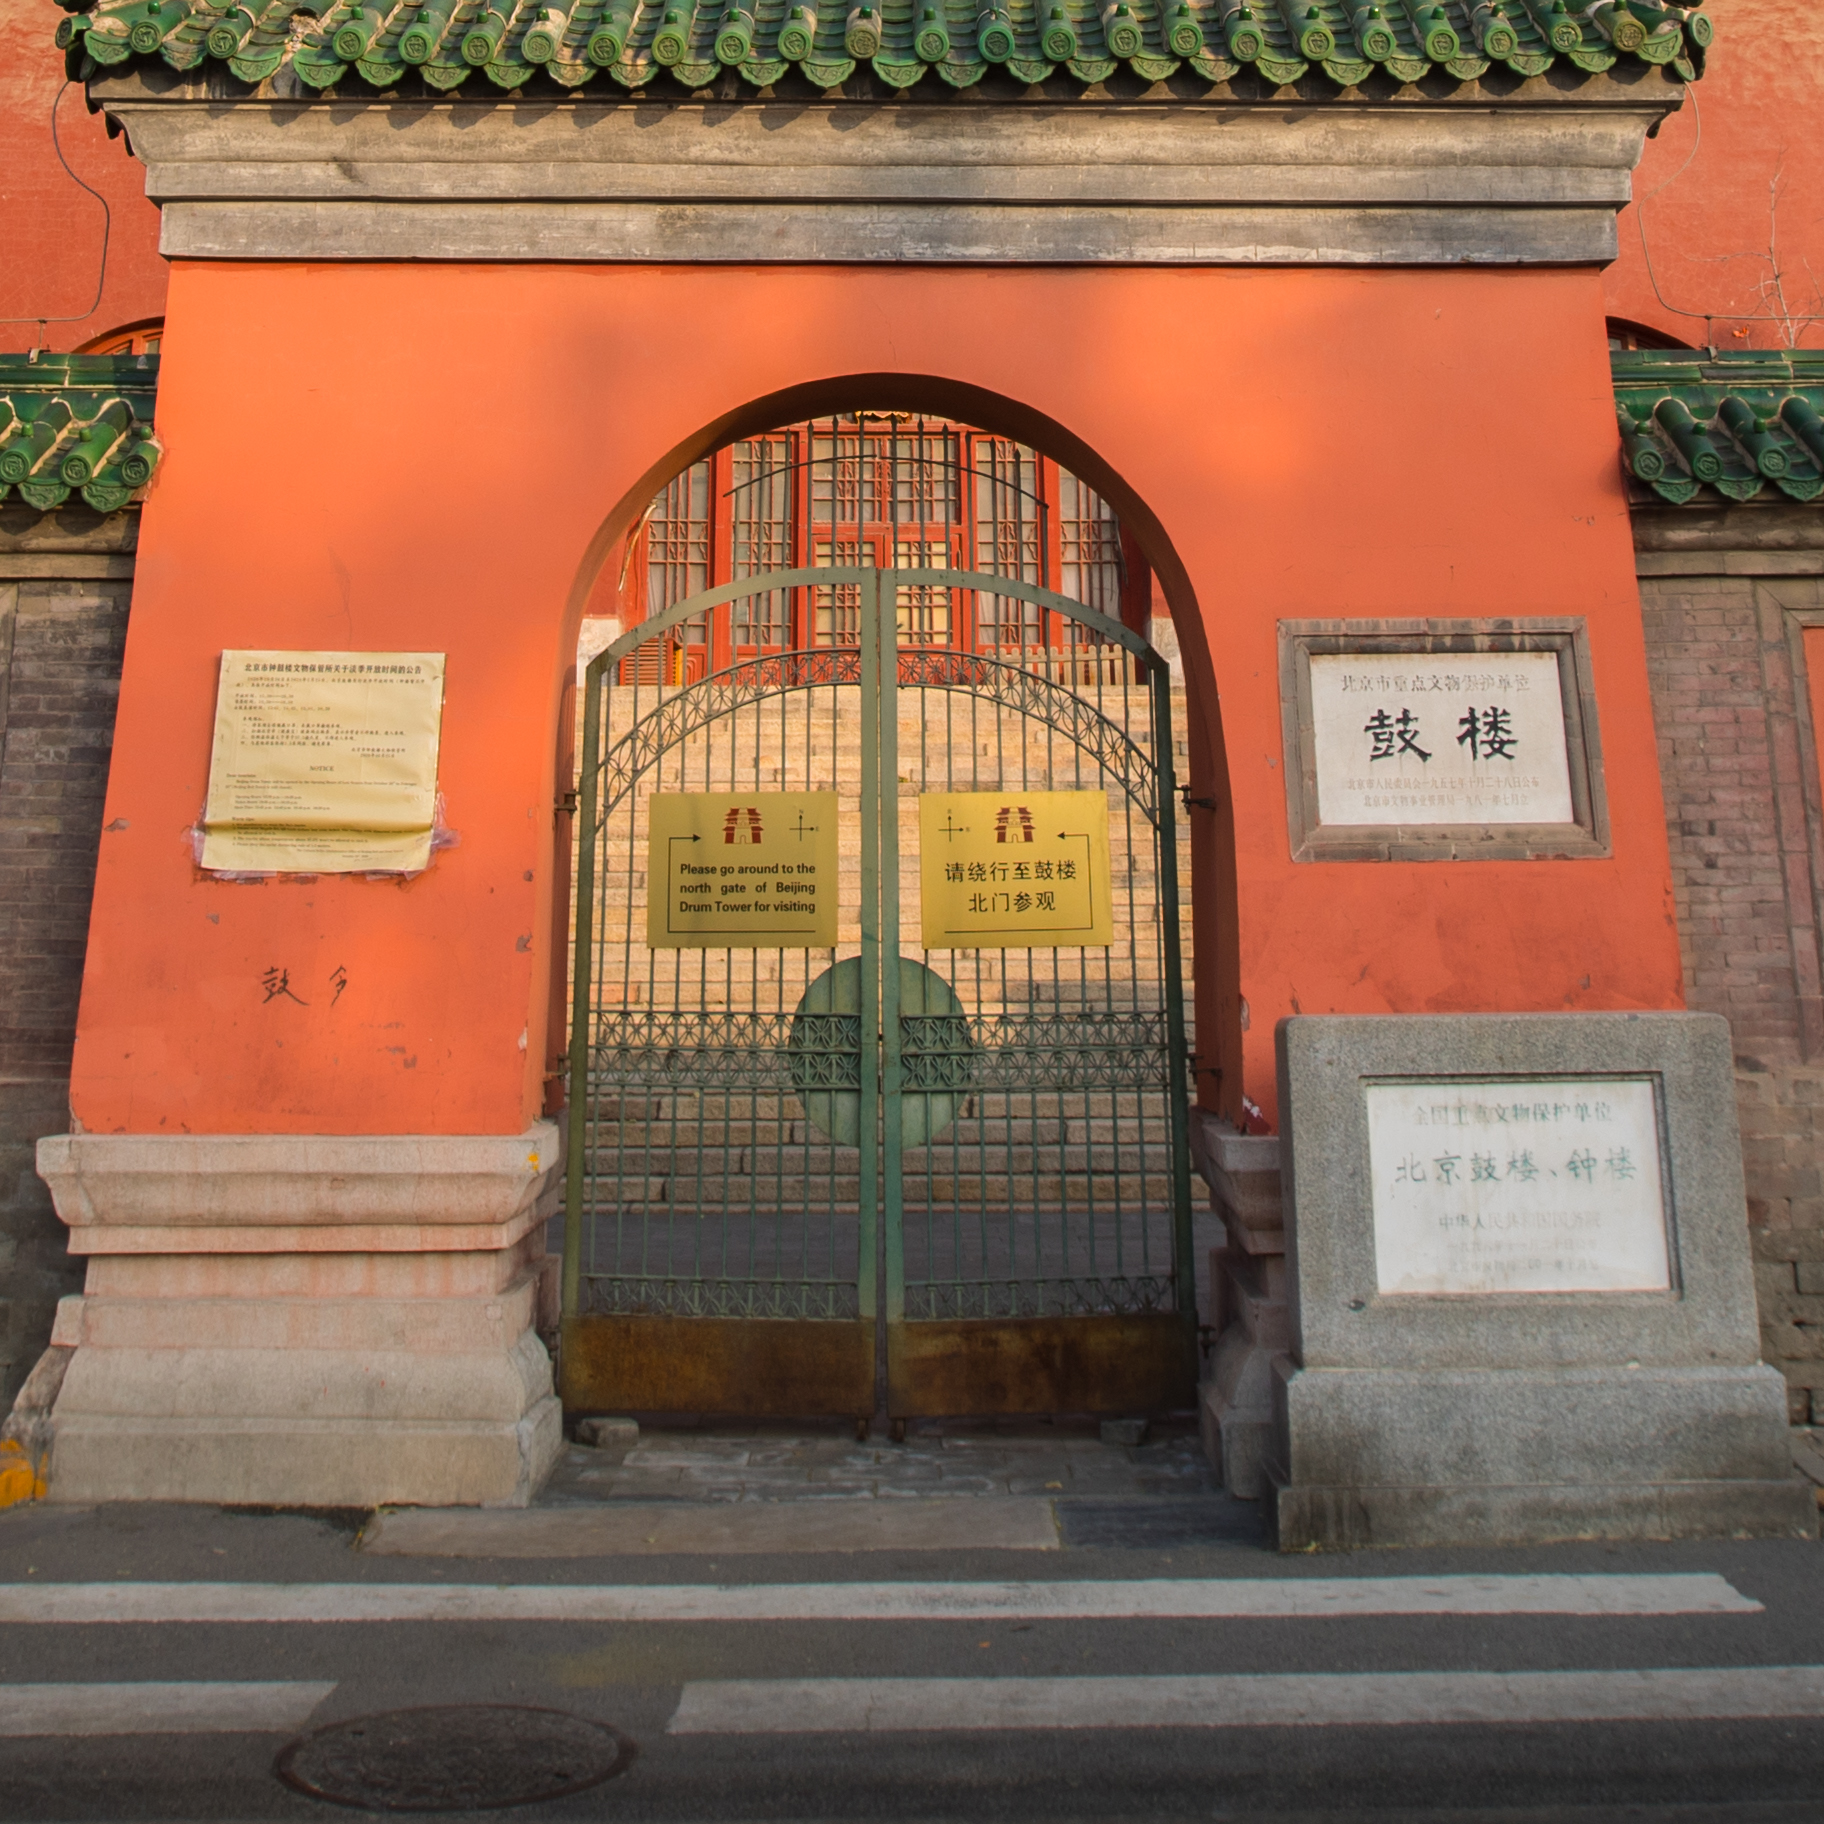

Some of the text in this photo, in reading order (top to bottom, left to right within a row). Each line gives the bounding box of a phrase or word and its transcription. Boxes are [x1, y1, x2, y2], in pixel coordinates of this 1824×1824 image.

[244, 663, 422, 675] 北京市钟鼓楼文物保管所关于淡季开放时间的公告
[1340, 674, 1530, 693] 北京市重点文物保护单位
[1363, 705, 1519, 763] 鼓楼
[680, 863, 816, 877] Please go around to the
[944, 860, 1076, 883] 请绕行至鼓楼
[680, 882, 816, 895] north gate of Beijing
[680, 901, 816, 914] Drum Tower for visiting
[968, 891, 1056, 913] 北门参观
[1414, 1101, 1612, 1126] 全国重点文物保护单位
[1394, 1146, 1638, 1186] 北京鼓楼、钟楼
